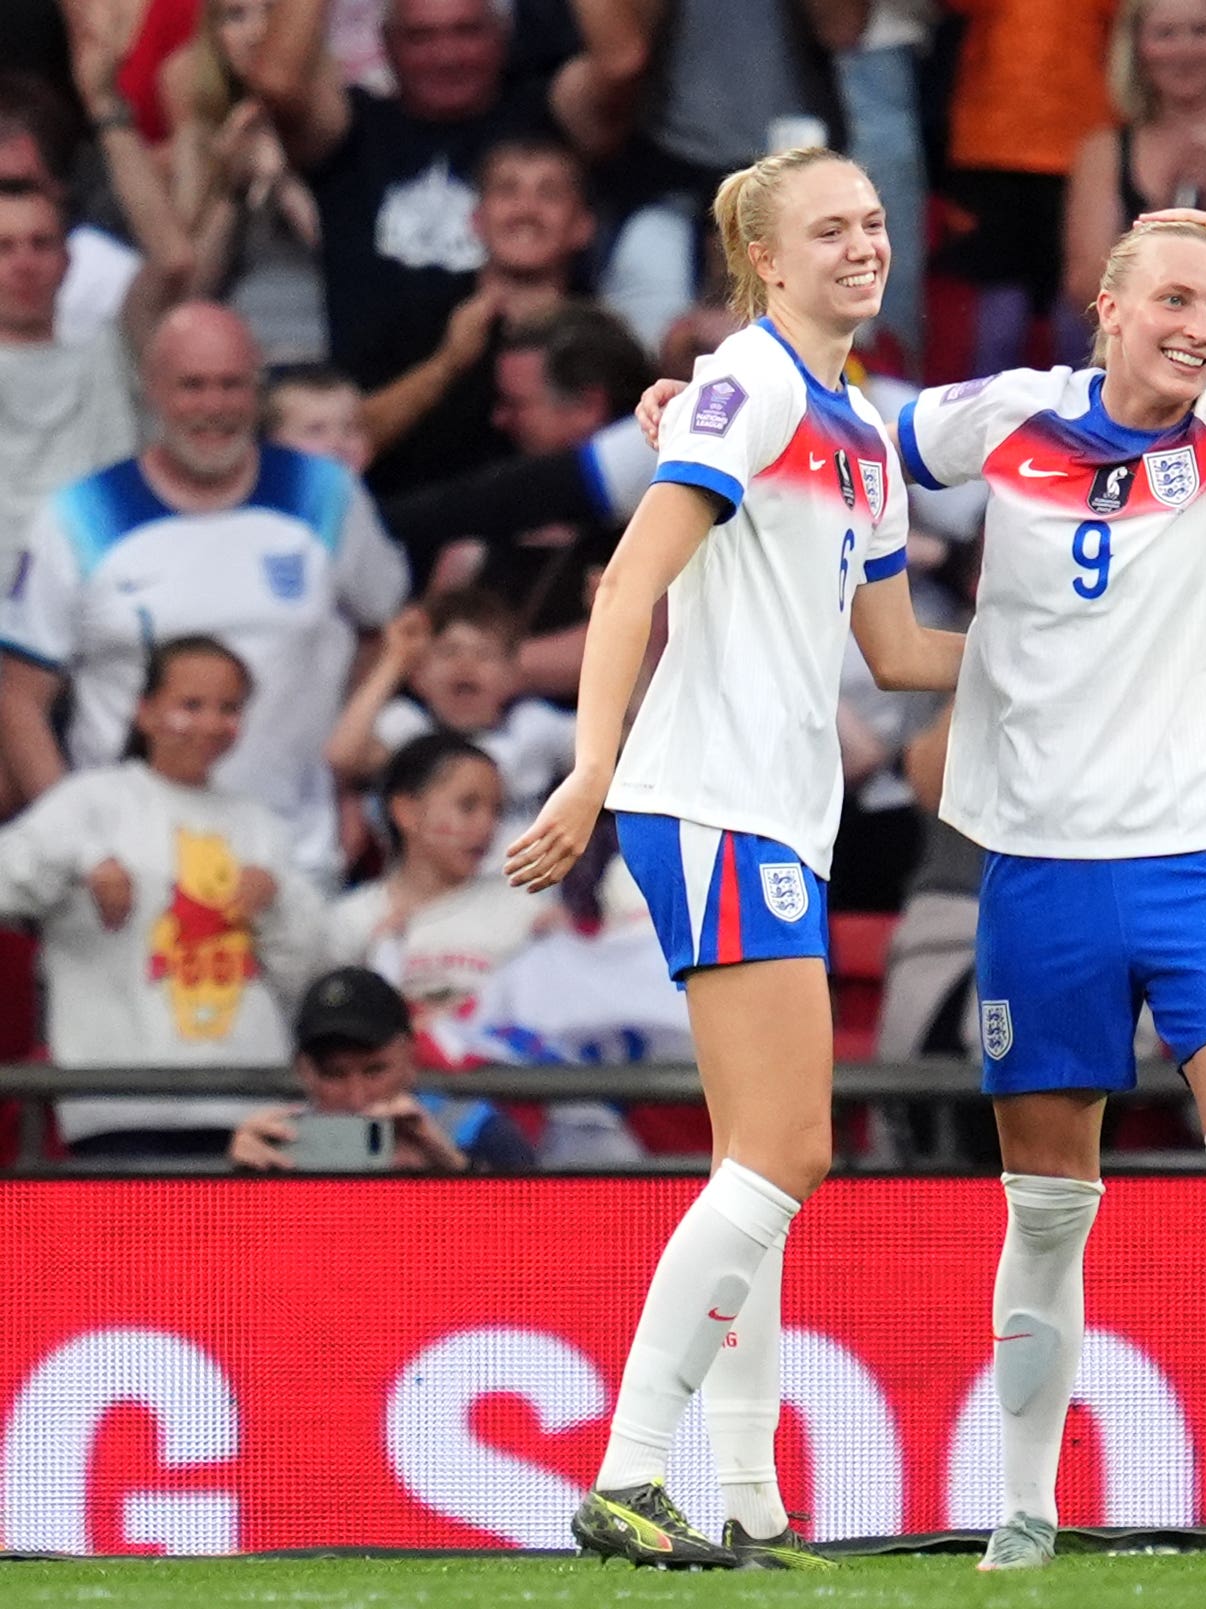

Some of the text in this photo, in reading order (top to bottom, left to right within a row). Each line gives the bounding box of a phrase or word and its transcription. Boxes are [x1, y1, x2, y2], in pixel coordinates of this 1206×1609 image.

[838, 528, 855, 613] 6
[1072, 519, 1112, 599] 9
[2, 1325, 240, 1554] G
